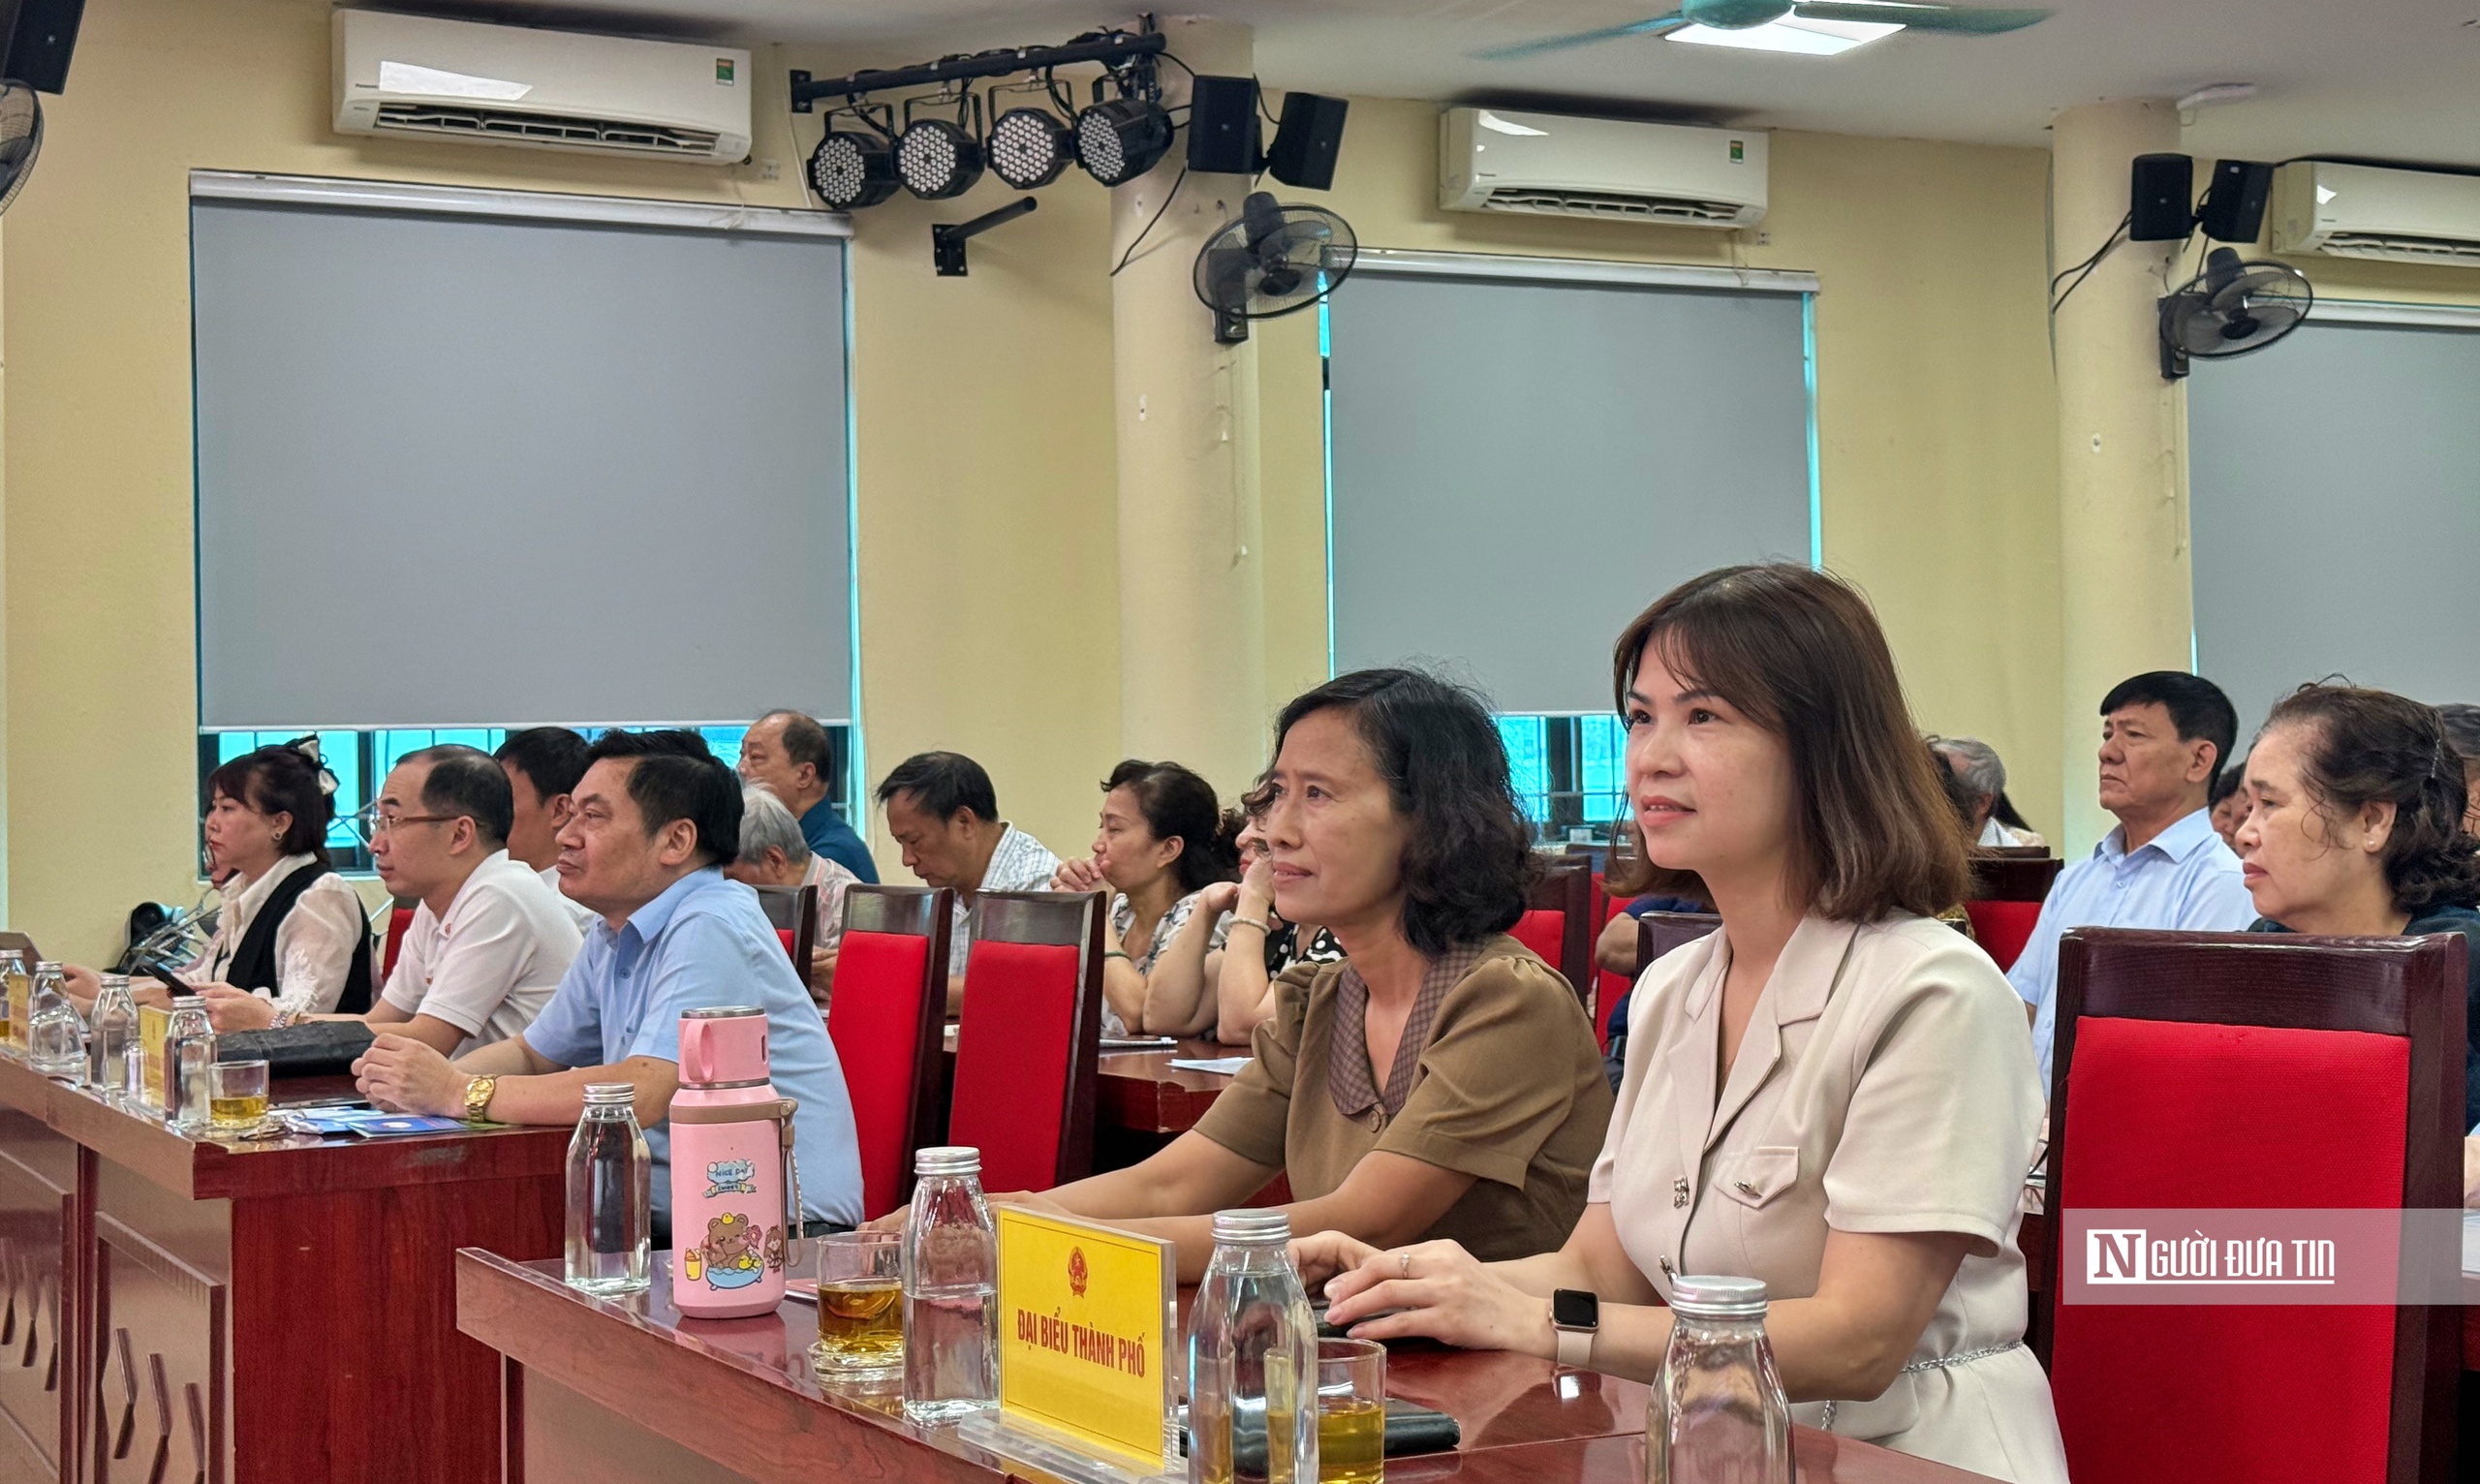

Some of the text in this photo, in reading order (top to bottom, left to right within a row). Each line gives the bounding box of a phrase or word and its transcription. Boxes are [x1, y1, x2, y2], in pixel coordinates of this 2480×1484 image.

[1017, 1306, 1147, 1379] ĐẠI BIỂU THÀNH PHỐ
